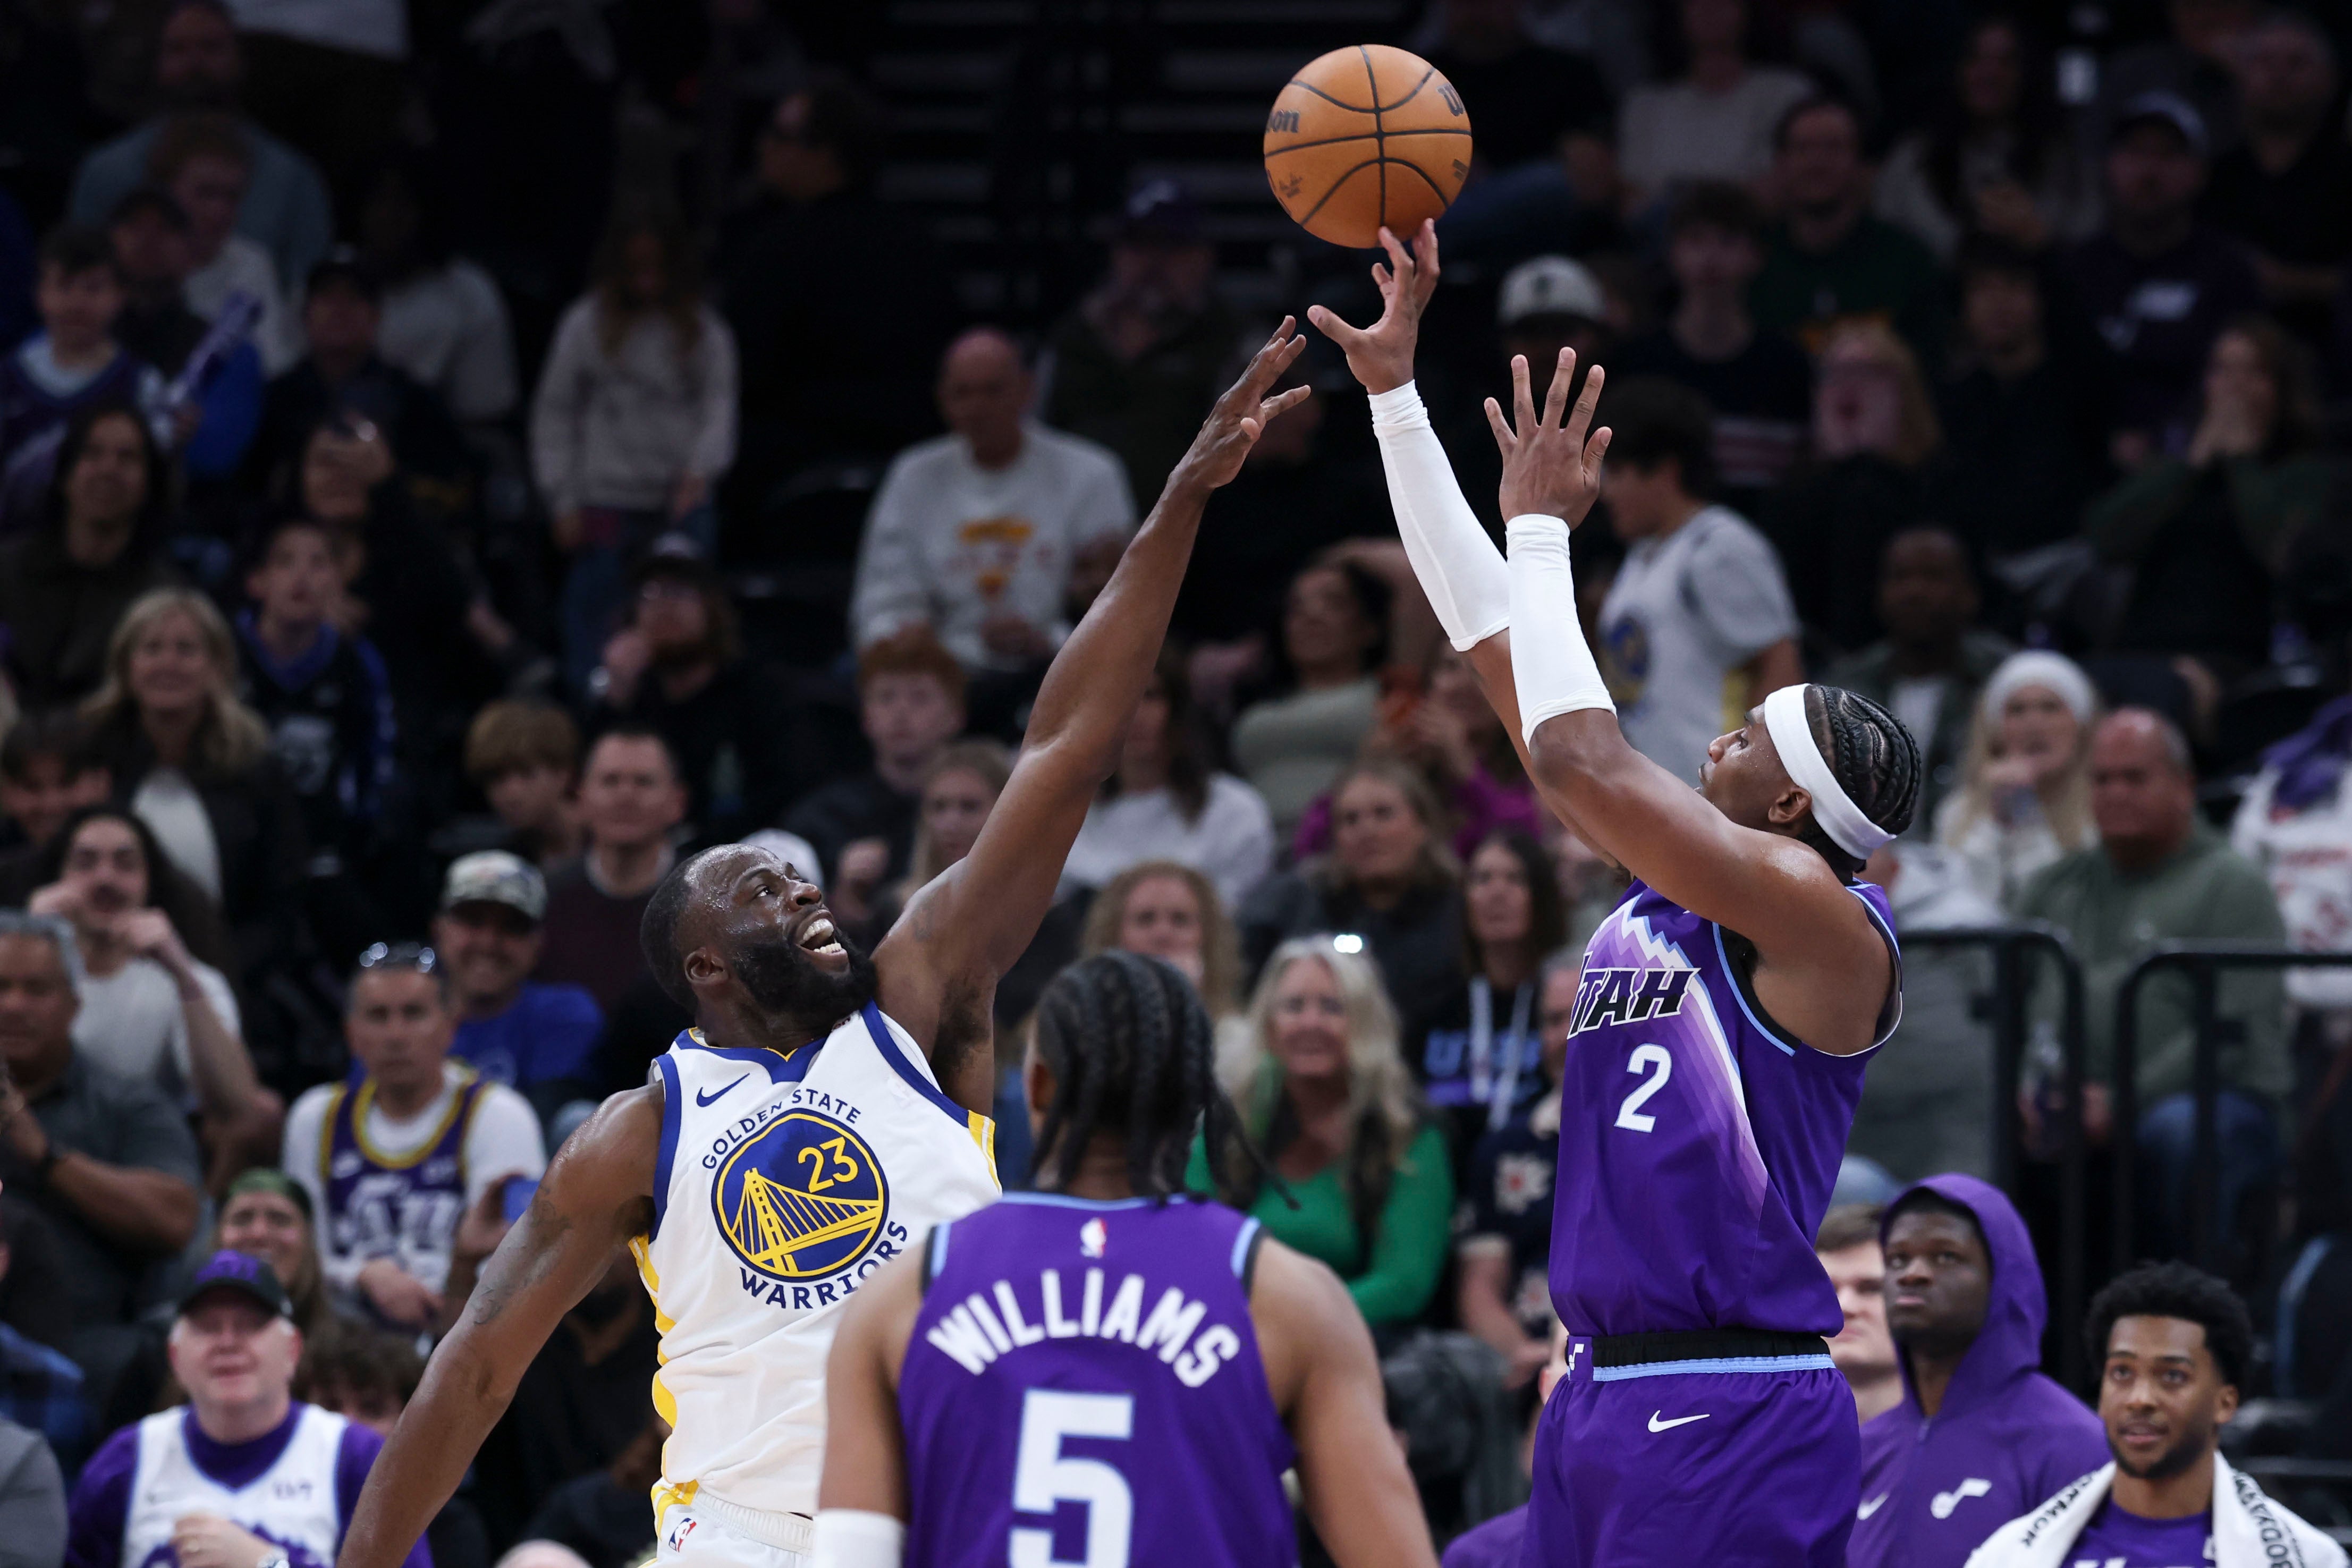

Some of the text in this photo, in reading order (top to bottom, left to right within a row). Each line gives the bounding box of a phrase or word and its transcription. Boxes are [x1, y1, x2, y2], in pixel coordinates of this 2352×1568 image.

[702, 1088, 862, 1170] GOLDEN STATE
[1614, 1043, 1672, 1133] 2
[798, 1137, 859, 1193] 23
[739, 1221, 908, 1310] WARRIORS
[926, 1268, 1241, 1388] WILLIAMS
[1008, 1387, 1135, 1568] 5
